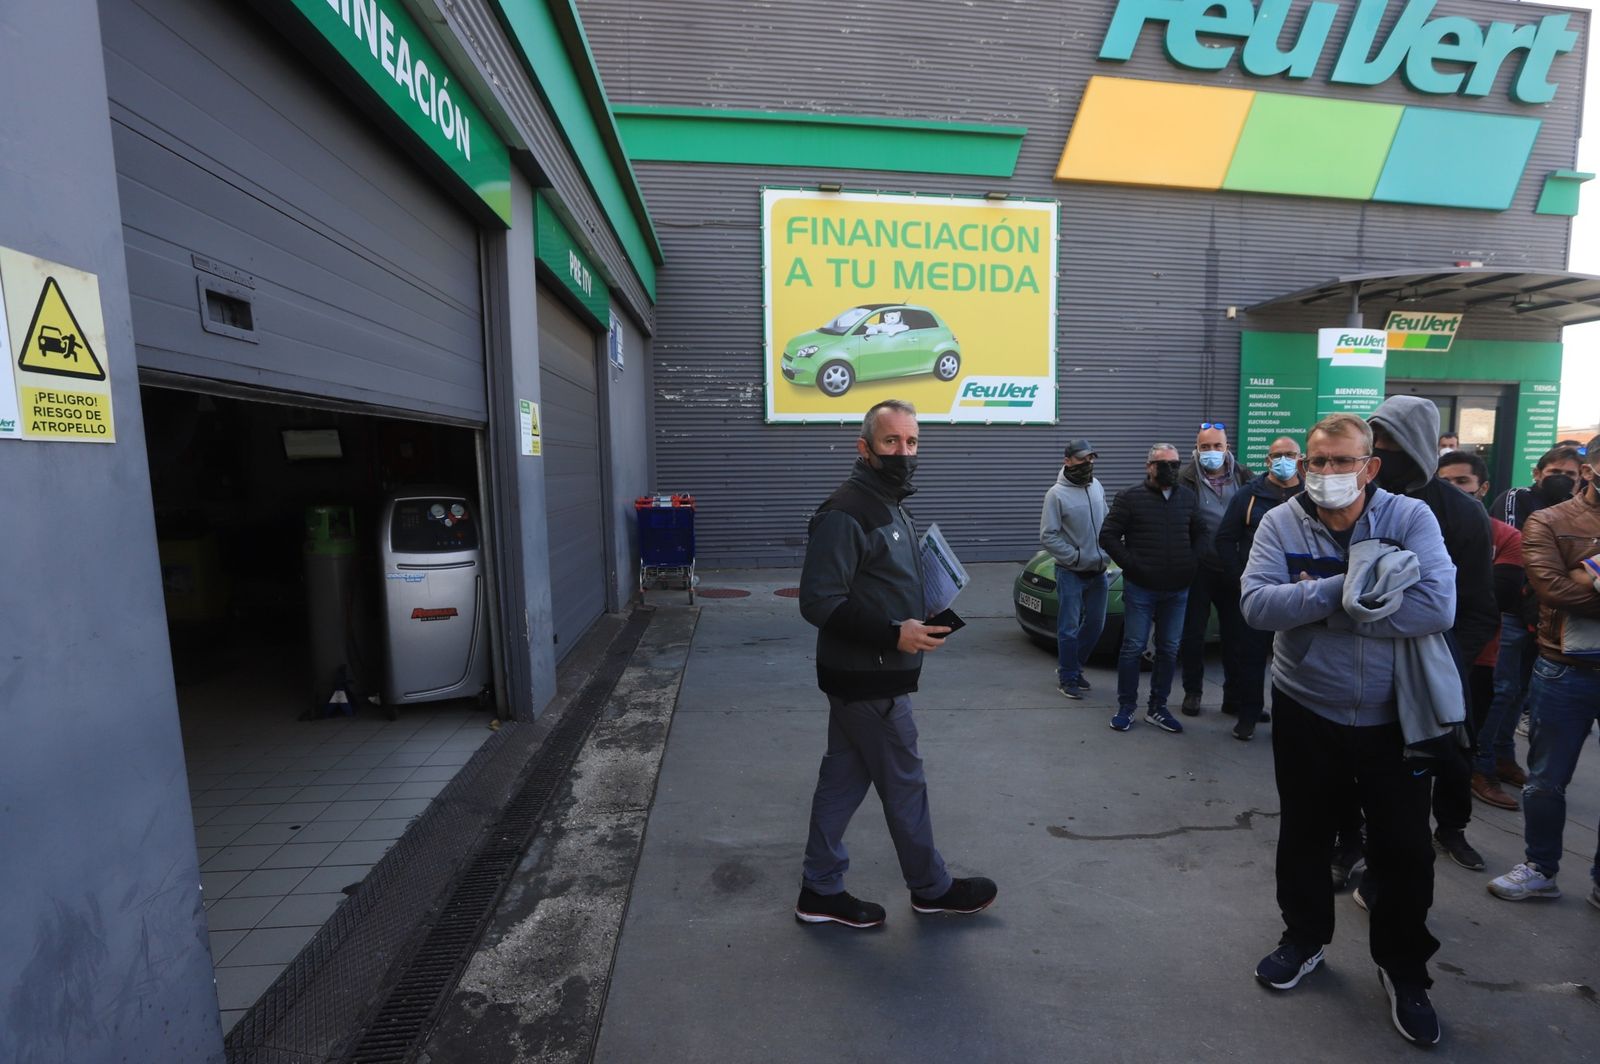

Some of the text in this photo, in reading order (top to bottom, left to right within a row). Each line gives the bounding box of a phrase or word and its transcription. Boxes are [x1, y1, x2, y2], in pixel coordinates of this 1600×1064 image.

[786, 216, 1040, 253] FINANCIACIÓN
[569, 249, 582, 287] PRE
[784, 257, 1040, 293] A TU MEDIDA
[1249, 378, 1274, 386] TALLER
[35, 392, 98, 407] ¡PELIGRO!
[1335, 388, 1378, 396] BIENVENIDOS
[33, 406, 102, 421] RIESGO DE
[31, 421, 106, 434] ATROPELLO
